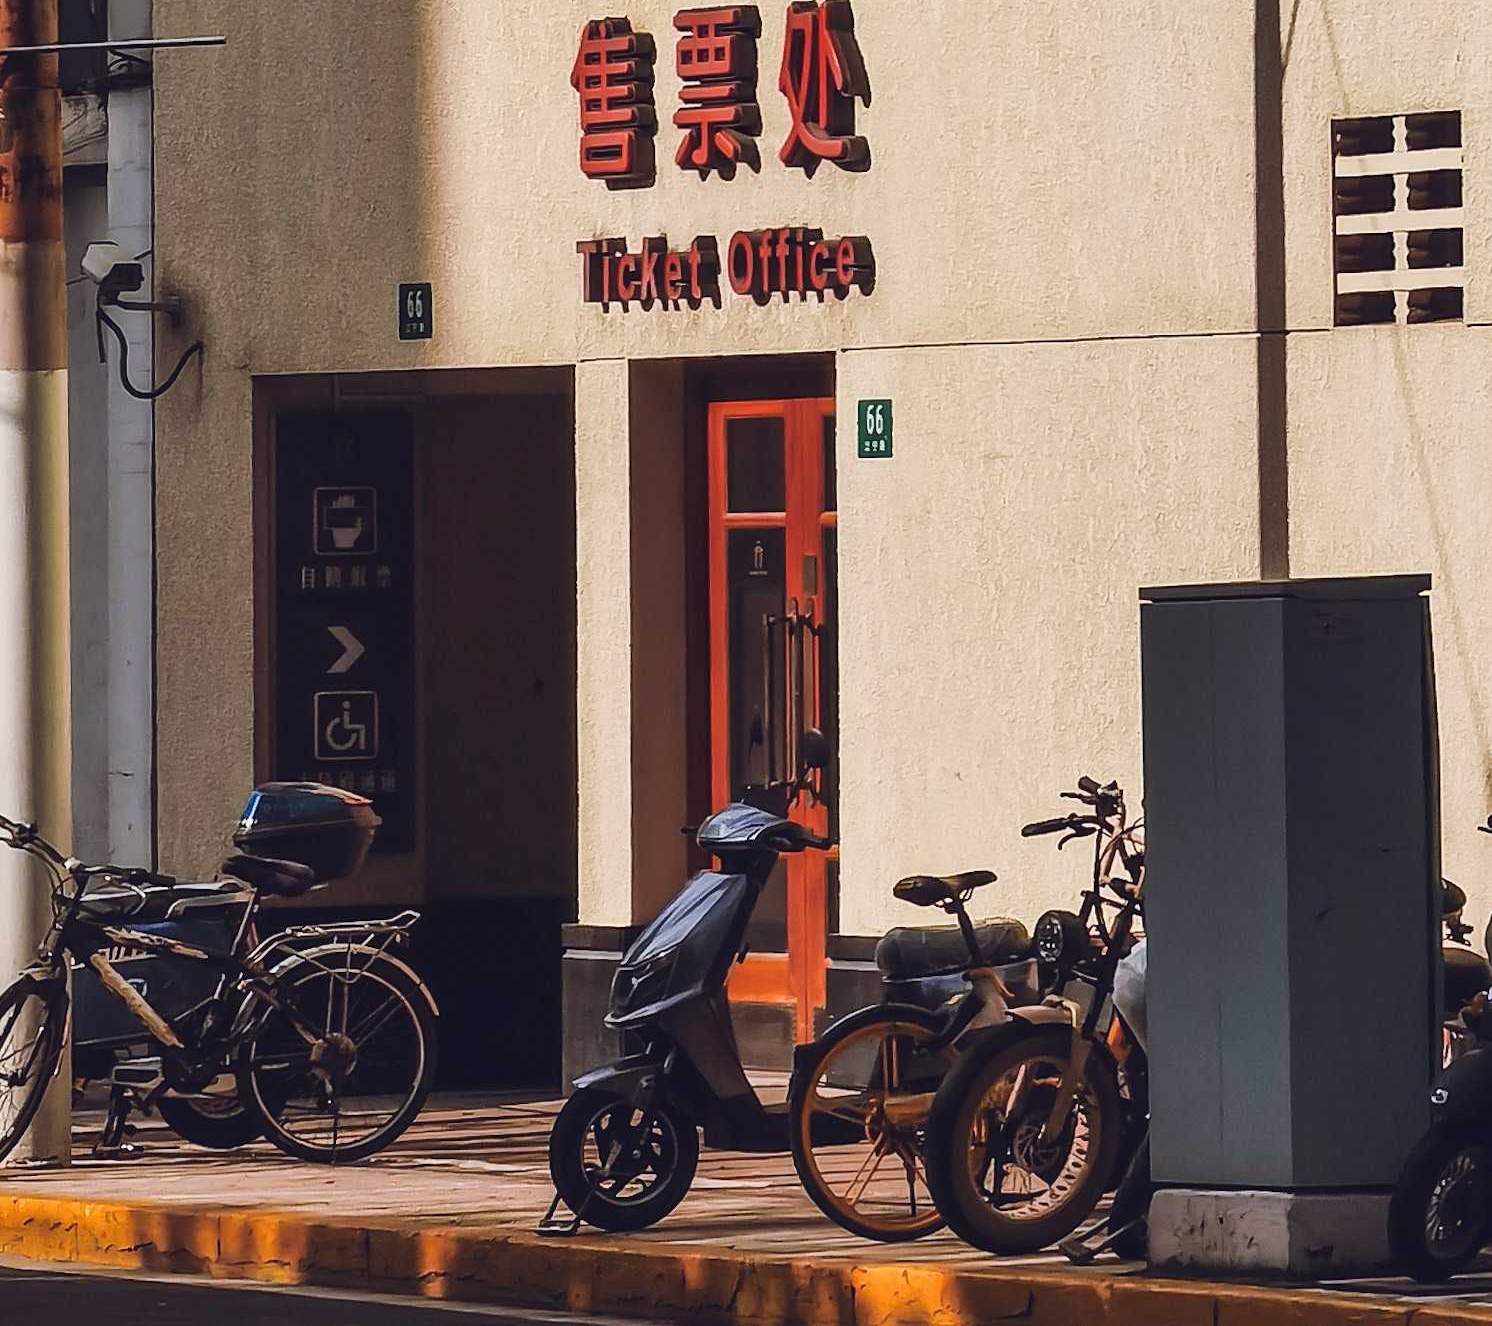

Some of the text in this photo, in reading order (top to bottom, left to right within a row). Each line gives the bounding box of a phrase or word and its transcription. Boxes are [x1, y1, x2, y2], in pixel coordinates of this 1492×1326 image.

[577, 228, 865, 306] Ticket Office
[407, 290, 423, 318] 66
[866, 404, 884, 435] 66
